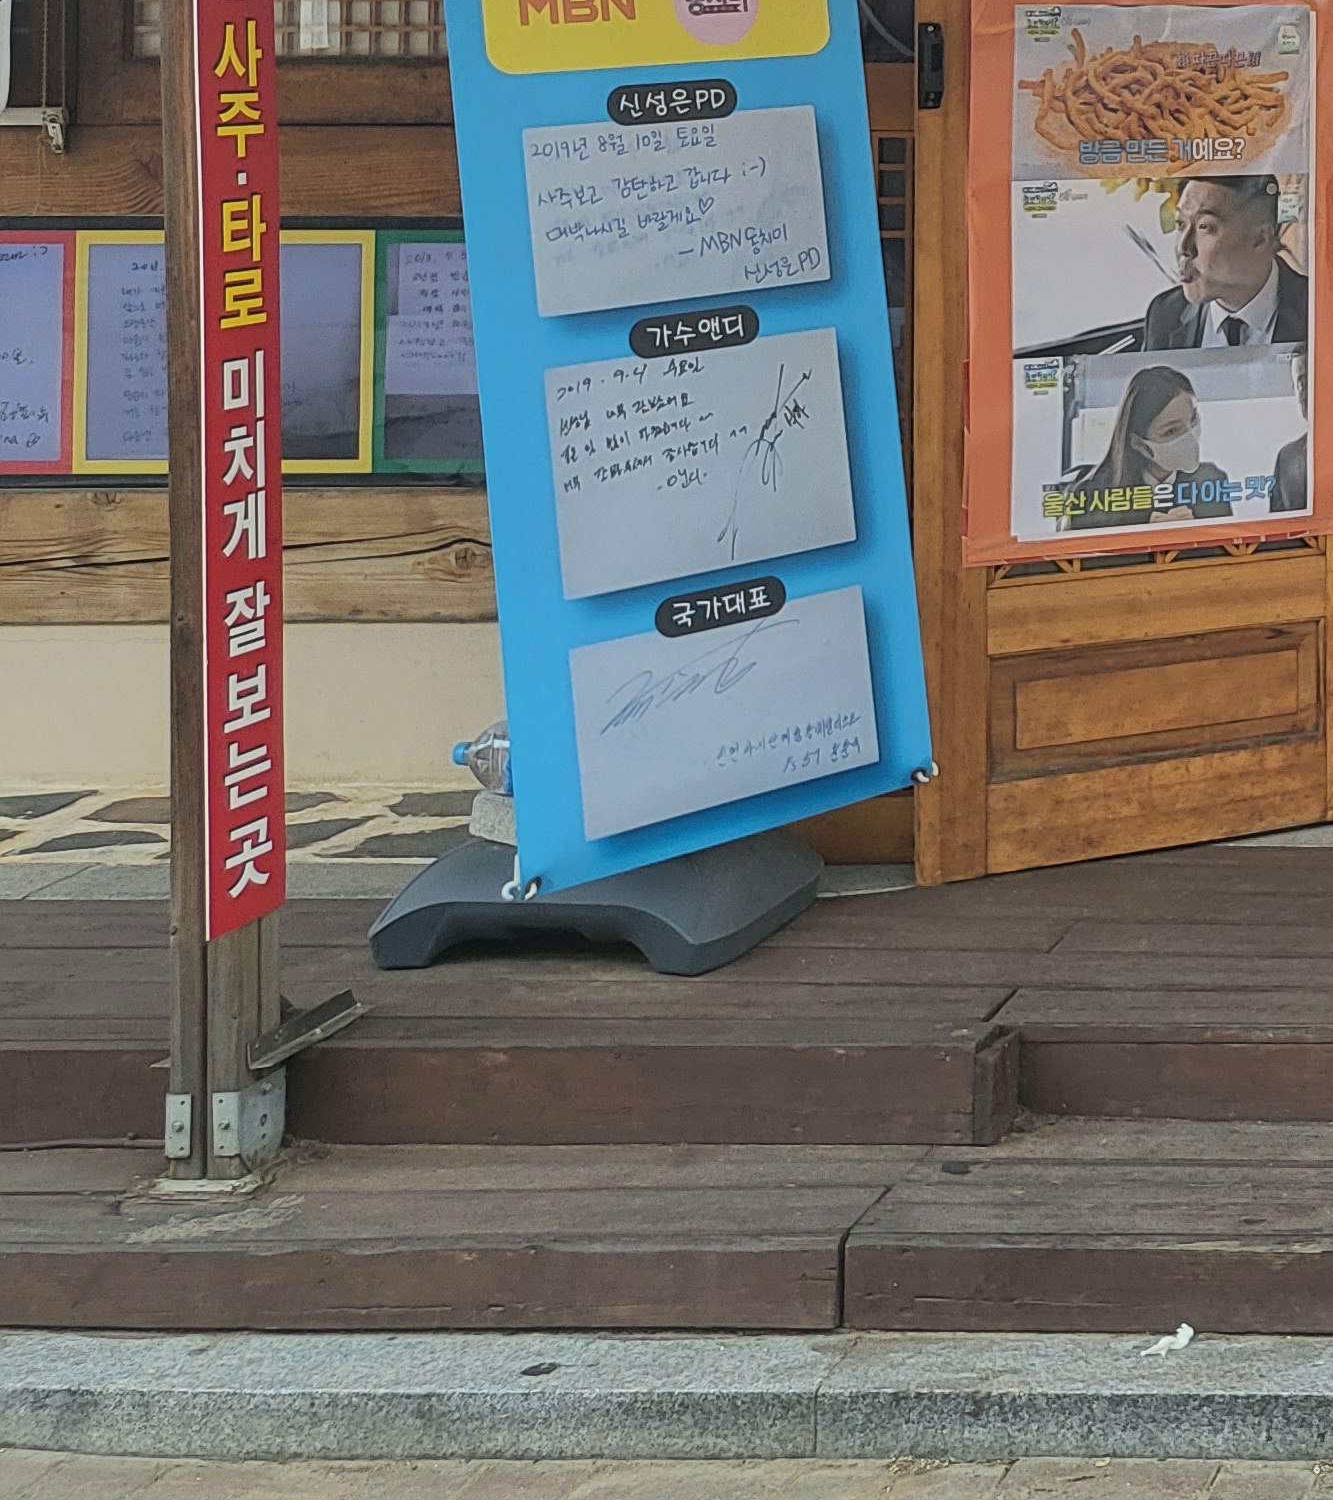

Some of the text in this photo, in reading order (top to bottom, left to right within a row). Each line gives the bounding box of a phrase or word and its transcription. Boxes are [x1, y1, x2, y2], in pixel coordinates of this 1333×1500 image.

[619, 87, 726, 118] 신성은PD
[531, 123, 718, 161] 2019년 8월 10일 토요일
[1078, 137, 1246, 165] 방금 만든 거예요?
[222, 349, 267, 560] 미치게
[1042, 476, 1278, 518] 울산 사람들은 다 아는 맛?
[672, 585, 772, 628] 국가대표
